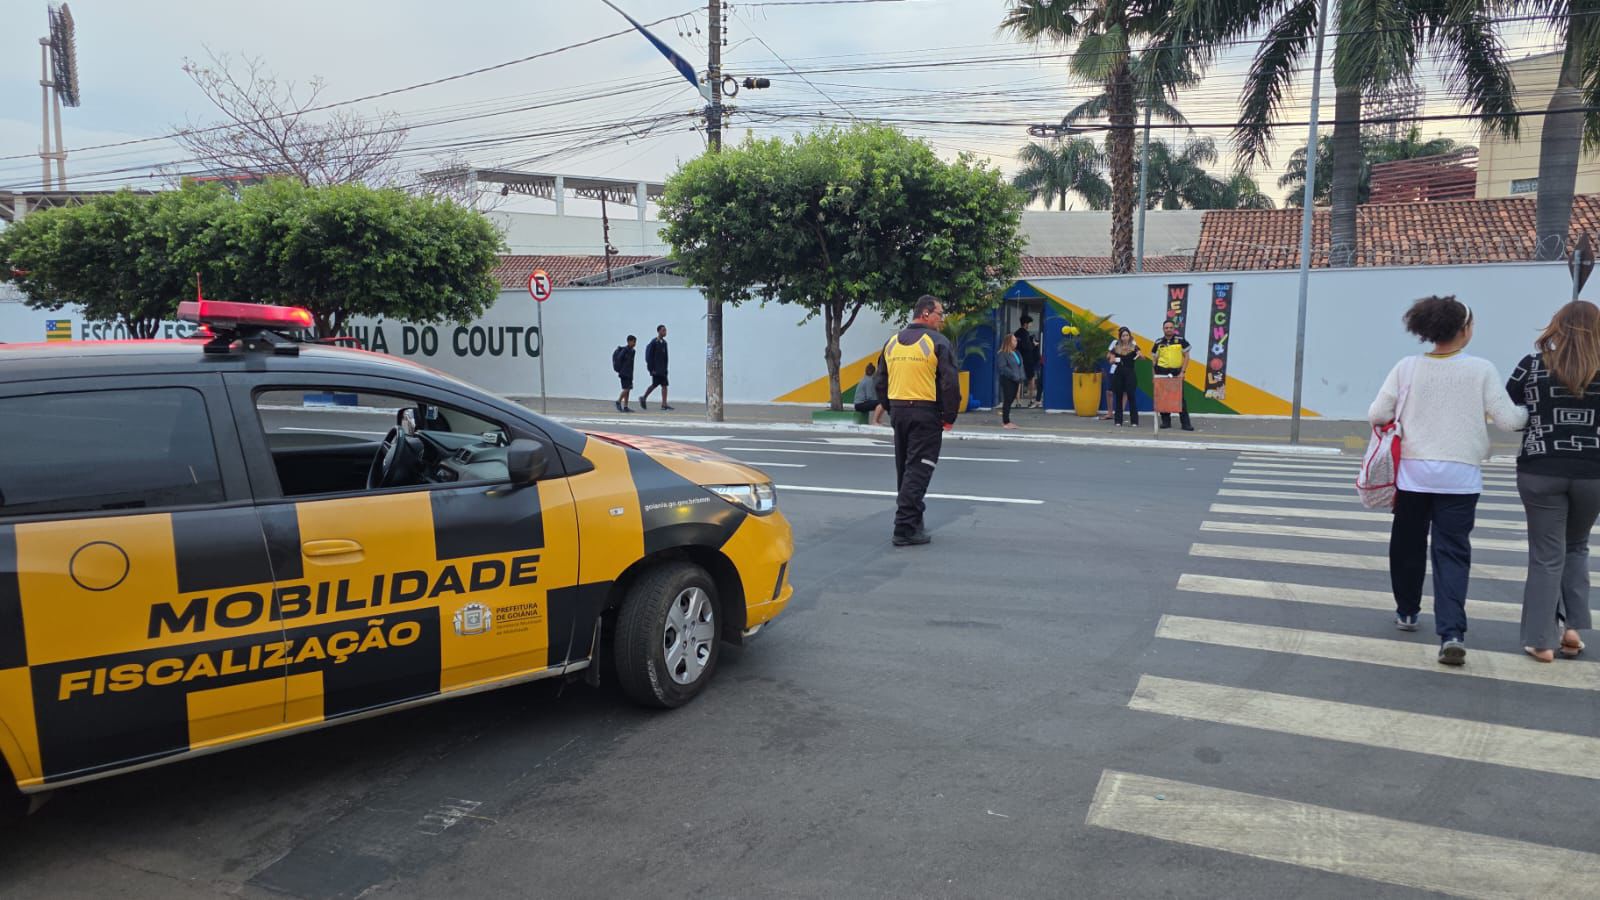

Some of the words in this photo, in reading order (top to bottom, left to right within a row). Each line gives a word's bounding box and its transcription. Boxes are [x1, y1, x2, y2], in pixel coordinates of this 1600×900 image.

[403, 325, 438, 357] DO
[453, 325, 543, 357] COUTO
[147, 554, 540, 639] MOBILIDADE
[496, 602, 538, 614] PREFEITURA
[58, 618, 421, 701] FISCALIZAÇÃO
